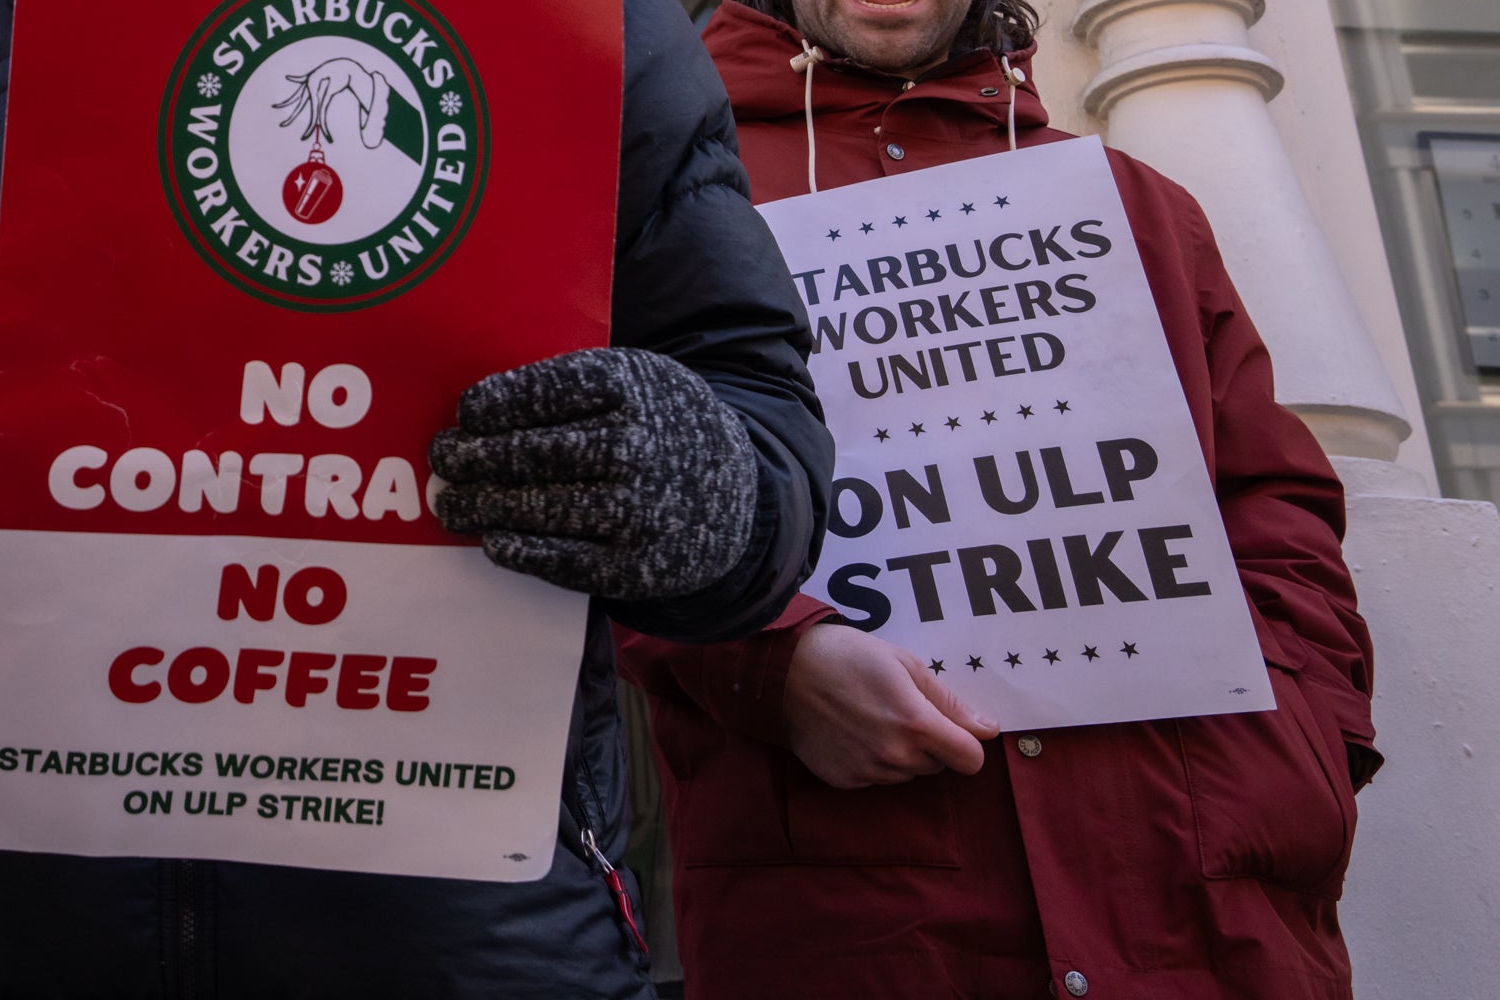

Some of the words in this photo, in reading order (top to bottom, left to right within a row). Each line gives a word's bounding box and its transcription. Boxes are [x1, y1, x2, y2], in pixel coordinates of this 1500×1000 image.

[186, 103, 323, 286] WORKERS
[358, 123, 467, 280] UNITED
[790, 219, 1112, 306] TARBUCKS
[811, 273, 1097, 355] WORKERS
[240, 360, 373, 430] NO
[847, 331, 1066, 400] UNITED
[48, 444, 451, 522] CONTRA
[827, 463, 952, 539] ON
[972, 437, 1159, 516] ULP
[216, 563, 348, 626] NO
[827, 523, 1213, 633] STRIKE
[108, 646, 438, 712] COFFEE
[122, 790, 173, 815] ON
[184, 791, 248, 817] ULP
[256, 794, 386, 826] STRIKE!
[215, 752, 385, 784] WORKERS
[395, 760, 516, 791] UNITED
